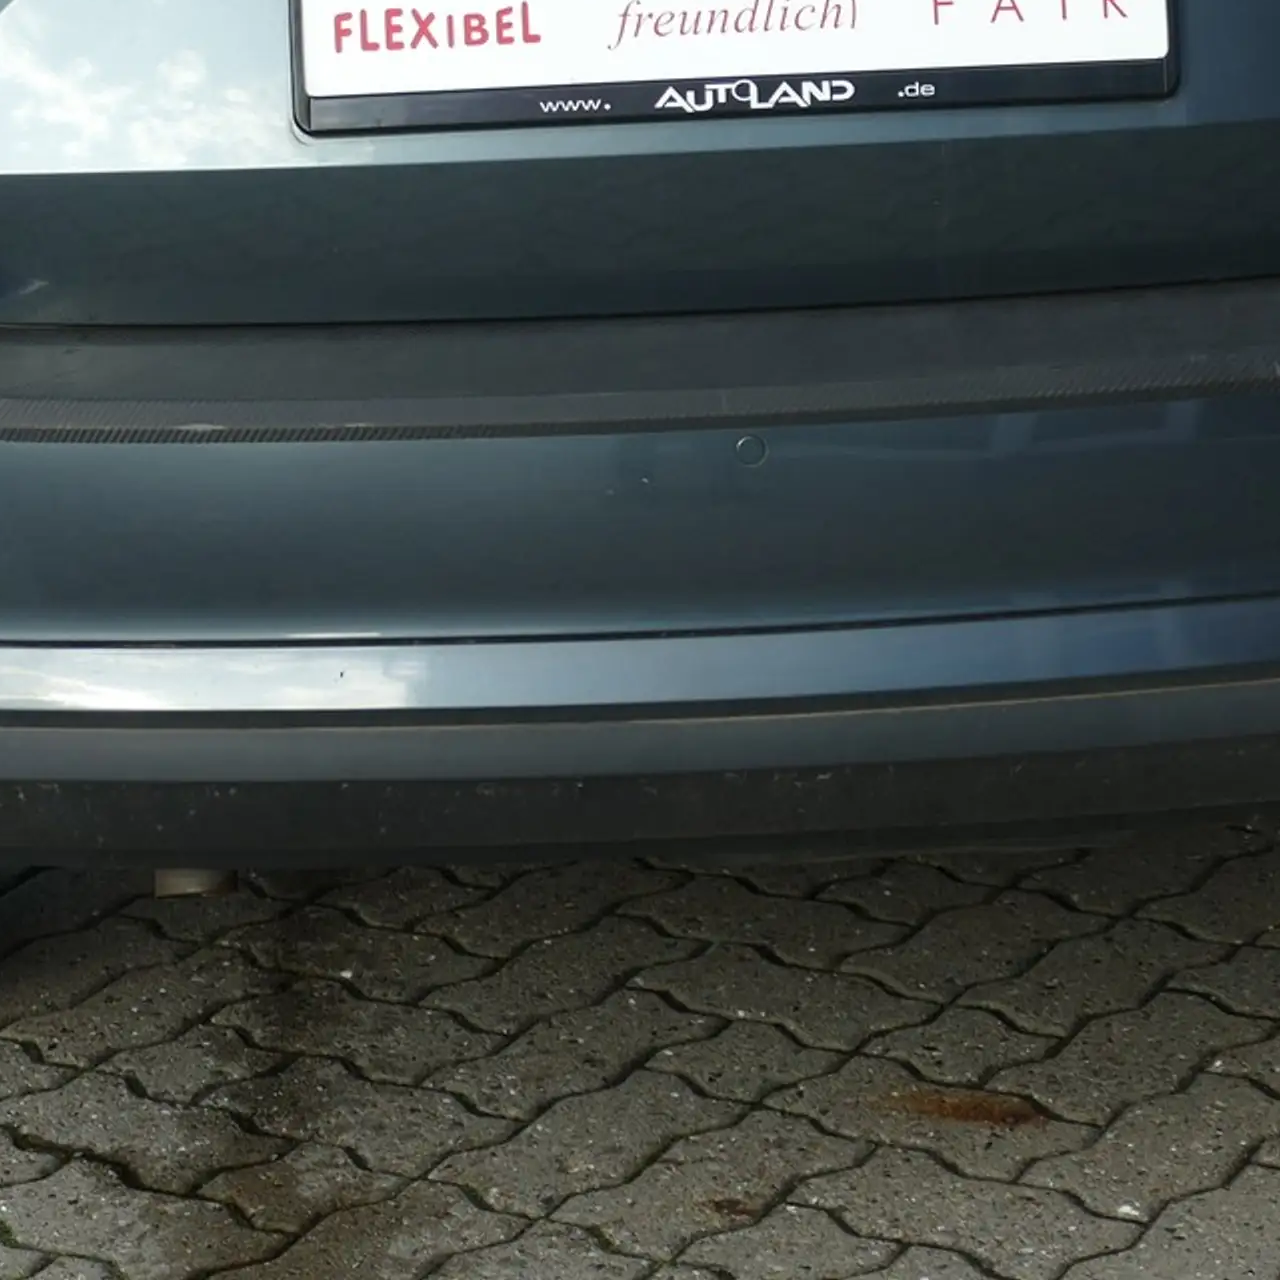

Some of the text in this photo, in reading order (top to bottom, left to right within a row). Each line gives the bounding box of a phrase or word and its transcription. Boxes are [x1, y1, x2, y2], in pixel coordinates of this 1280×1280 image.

[333, 1, 542, 54] FLEXIBEL
[539, 78, 936, 114] www. AUTOLAND .de
